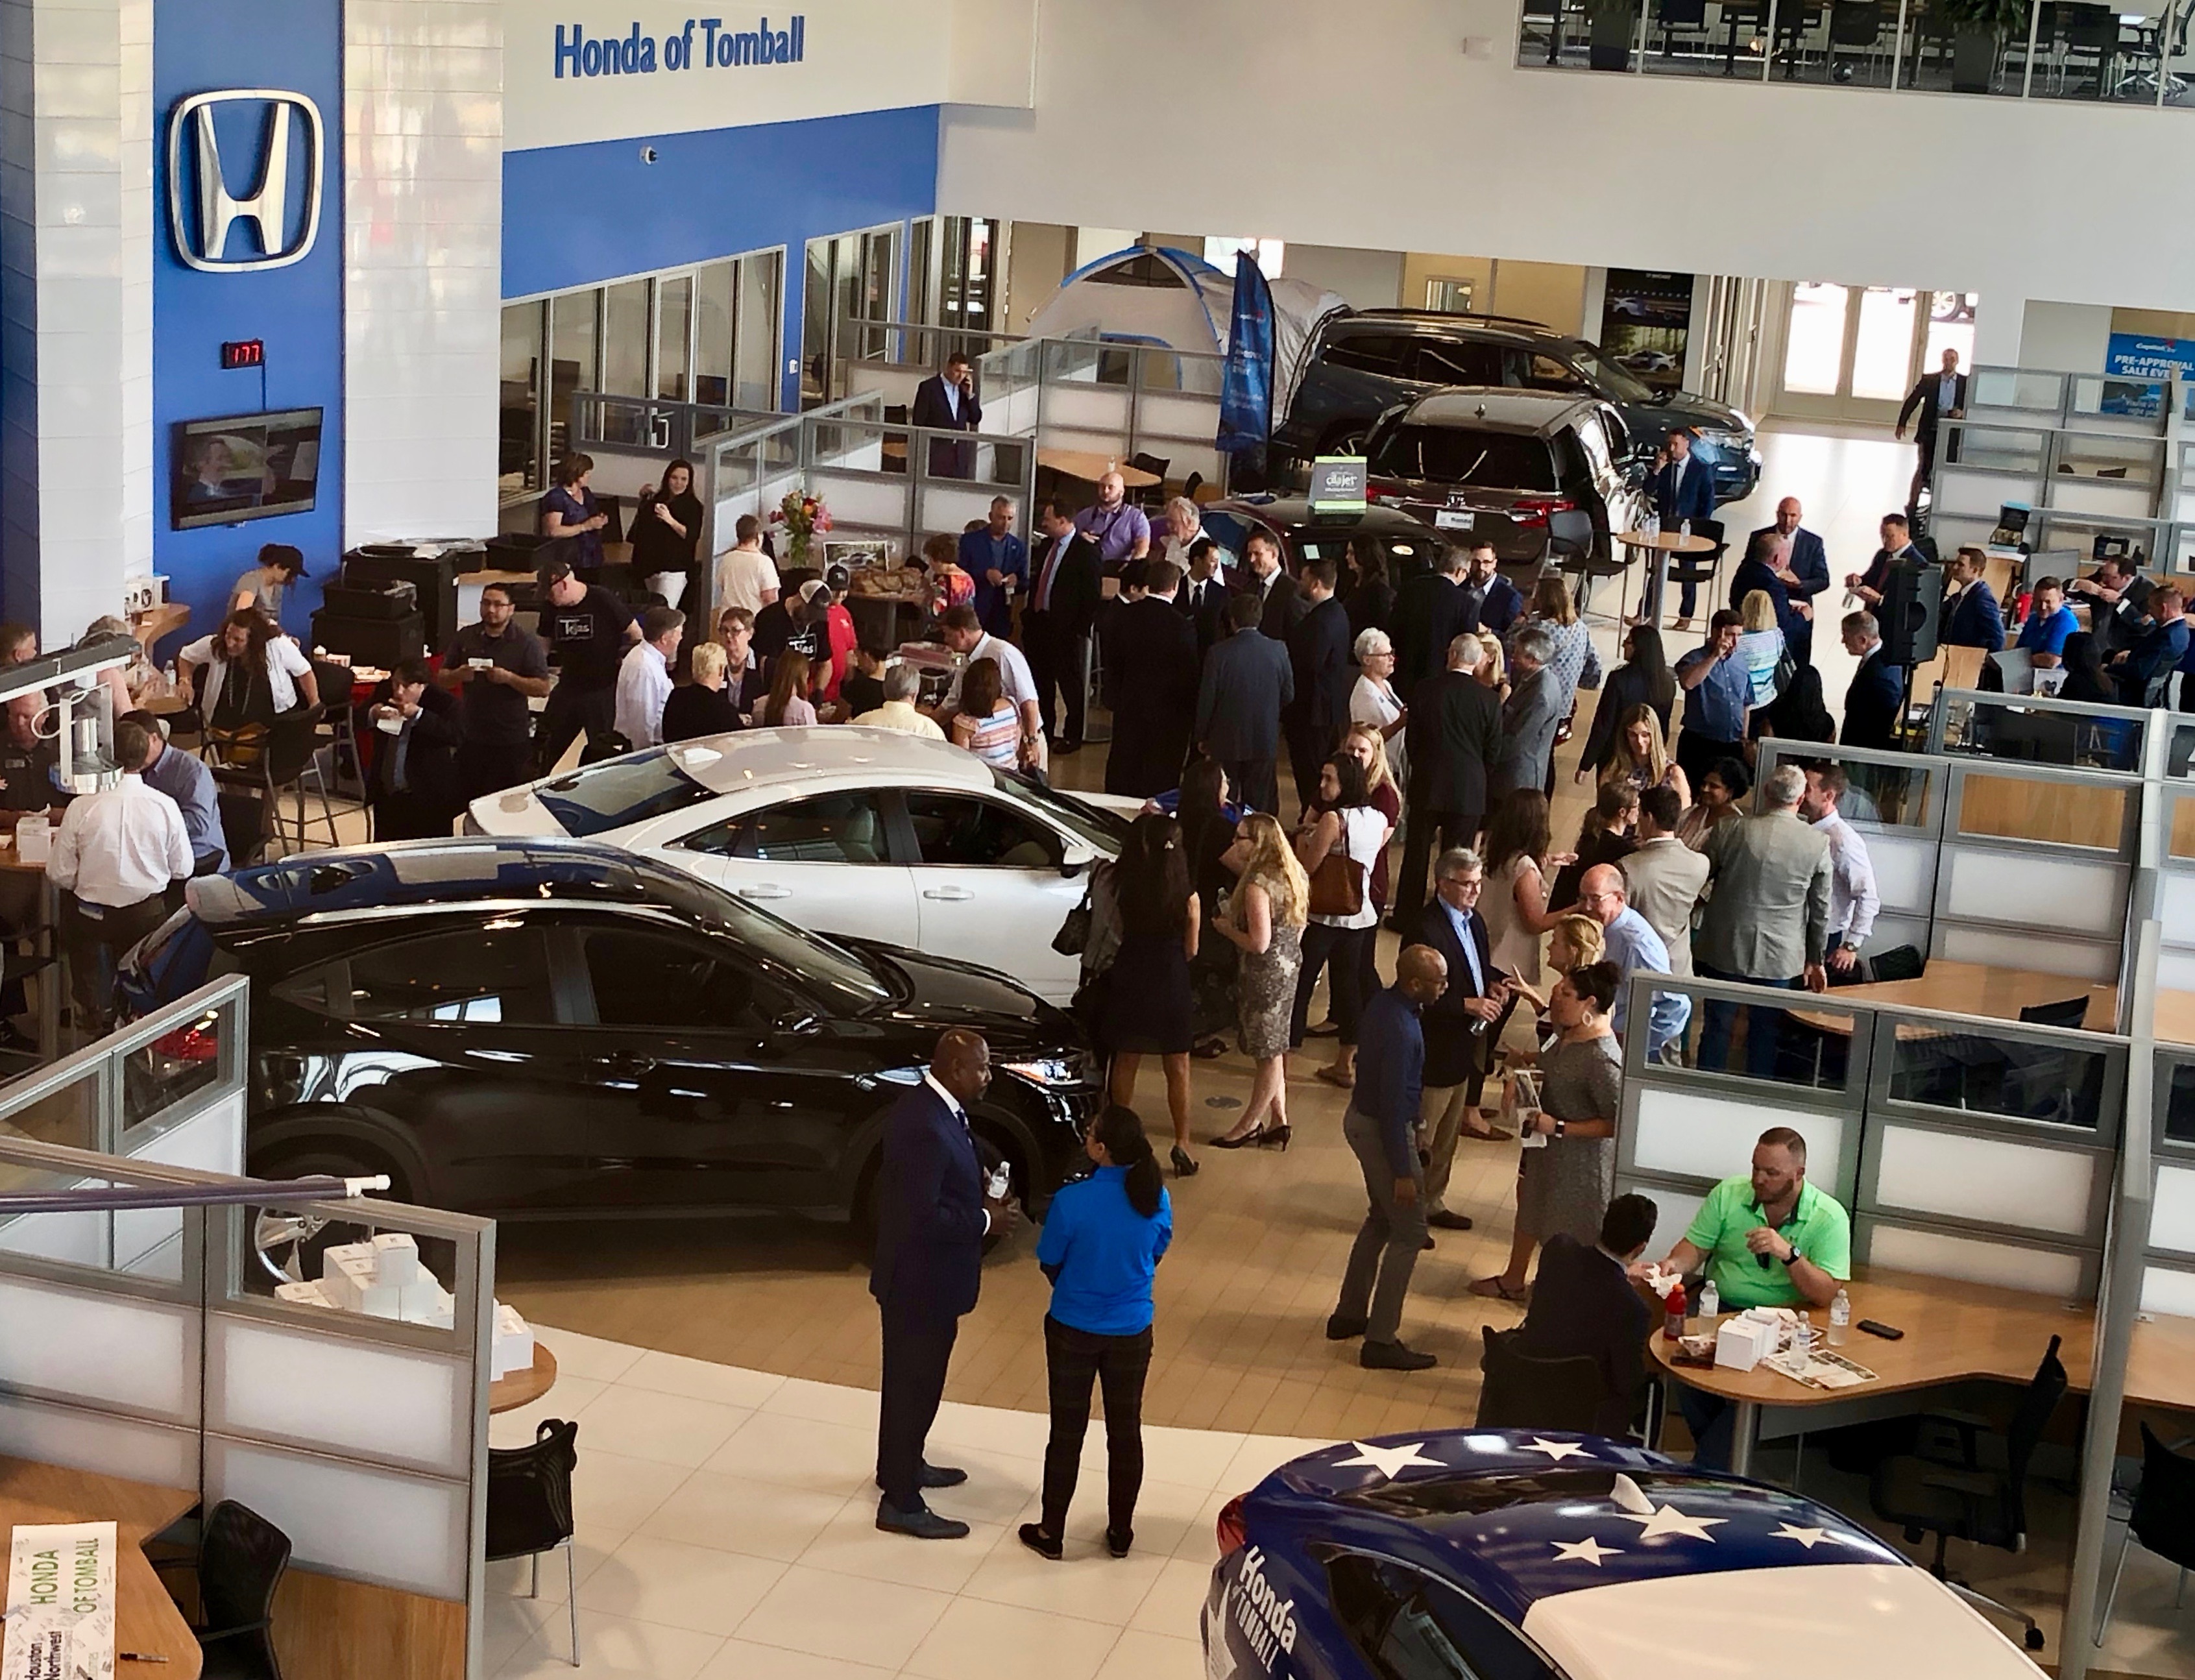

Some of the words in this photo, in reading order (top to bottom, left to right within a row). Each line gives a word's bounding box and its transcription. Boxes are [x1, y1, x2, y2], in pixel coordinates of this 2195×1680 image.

[555, 22, 657, 79] Honda
[664, 19, 696, 71] of
[700, 16, 805, 68] Tomball
[2122, 365, 2149, 376] SALE
[30, 1549, 59, 1605] HONDA
[73, 1538, 99, 1594] TOMBALL
[73, 1596, 97, 1613] OF
[1239, 1544, 1297, 1655] Honda
[1235, 1592, 1279, 1674] TOMBALL
